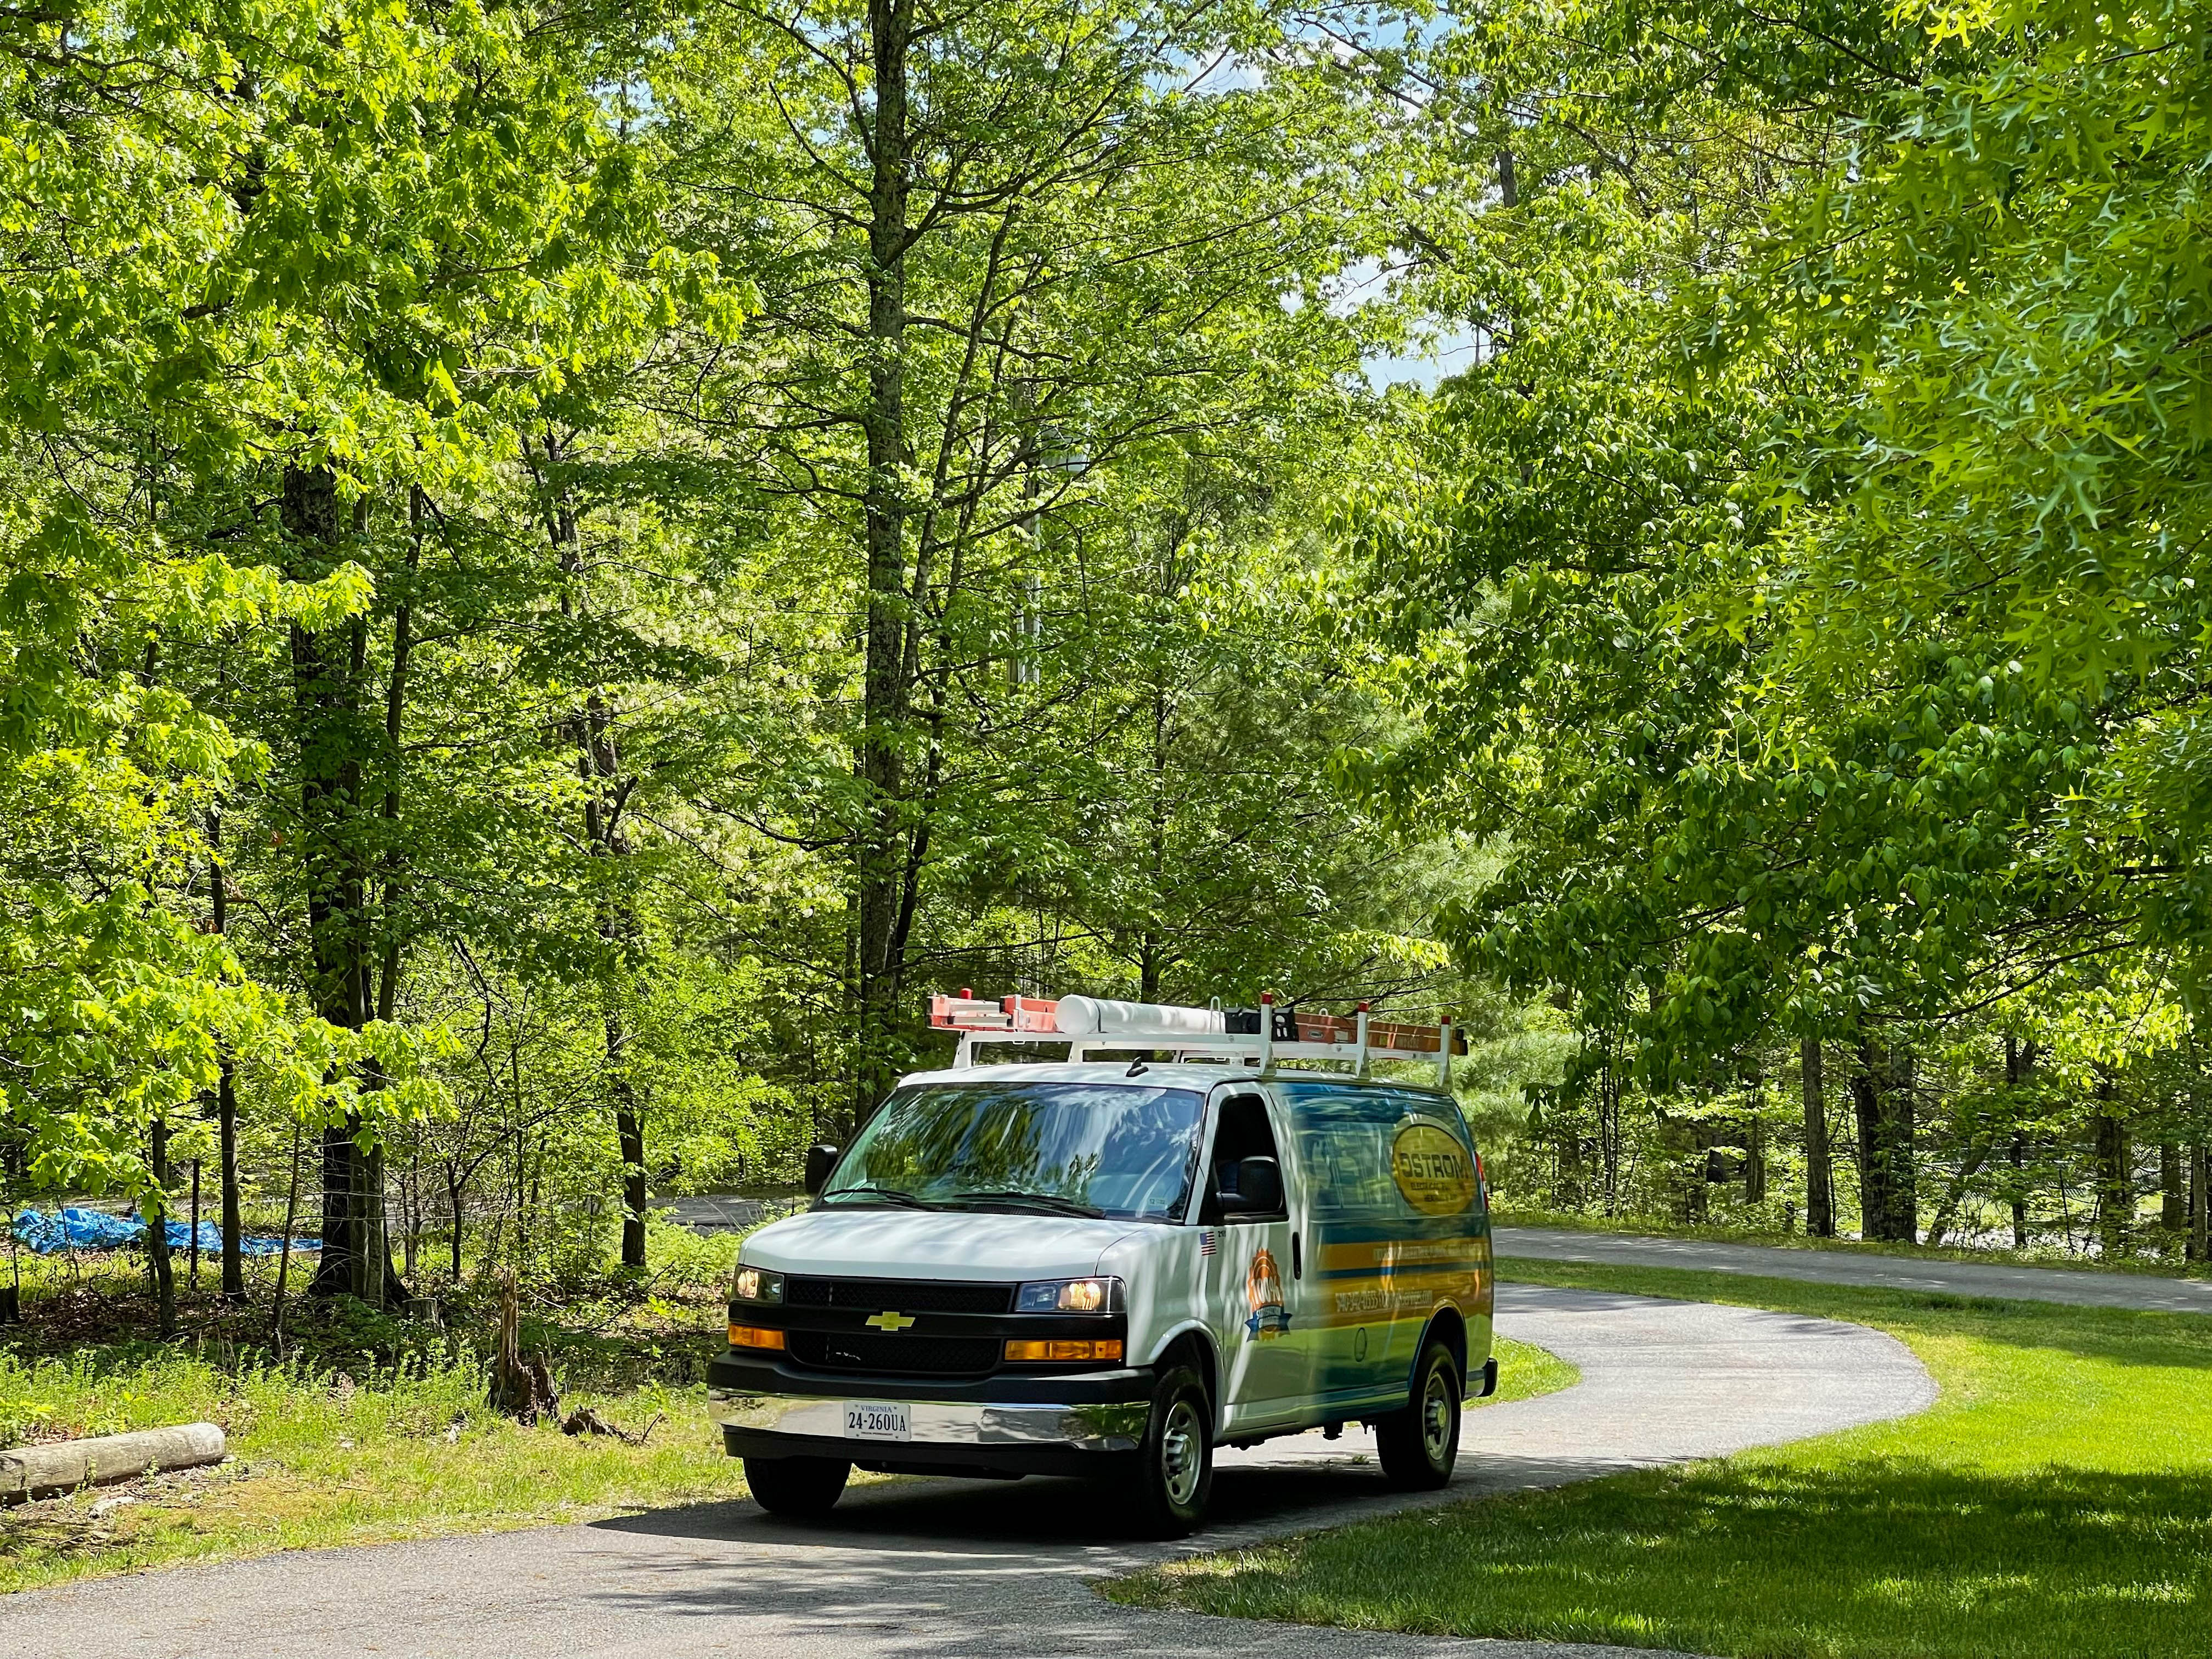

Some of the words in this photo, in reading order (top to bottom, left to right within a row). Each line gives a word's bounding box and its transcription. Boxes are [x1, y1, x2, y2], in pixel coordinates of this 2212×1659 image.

[1400, 1153, 1469, 1178] OSTROM
[1251, 1276, 1280, 1305] 100%
[861, 1405, 892, 1413] VIRGINIA
[849, 1412, 906, 1432] 24-260UA
